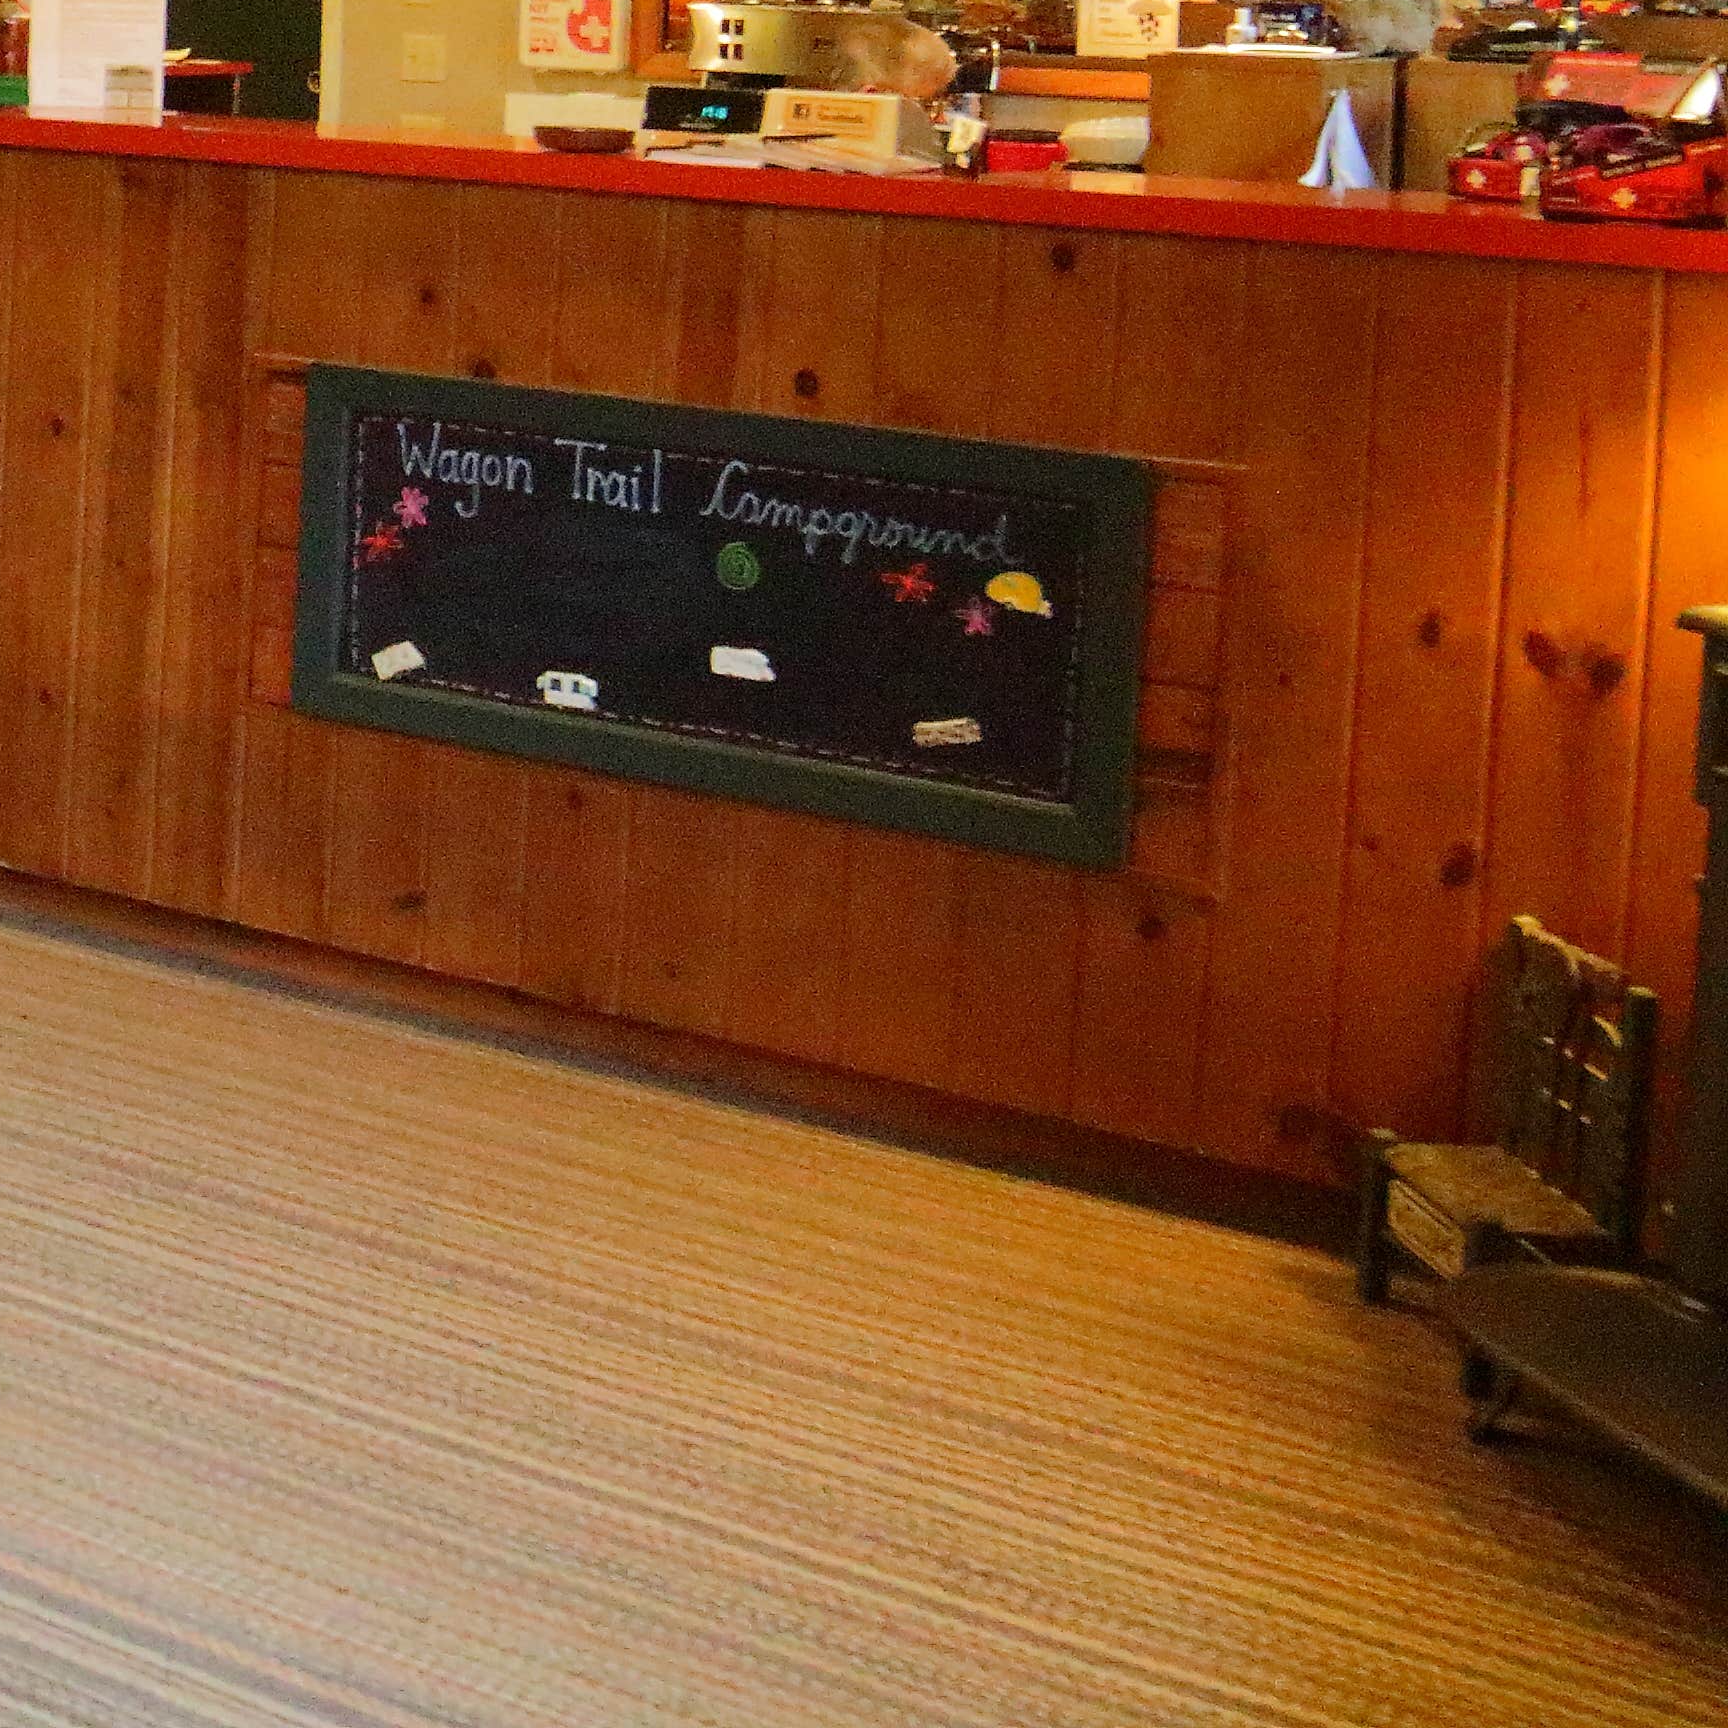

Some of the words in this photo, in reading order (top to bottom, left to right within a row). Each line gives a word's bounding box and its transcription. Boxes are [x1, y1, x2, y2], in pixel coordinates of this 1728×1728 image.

[396, 421, 534, 519] Wagon
[552, 437, 663, 515] Trail
[698, 459, 1025, 565] Campground
